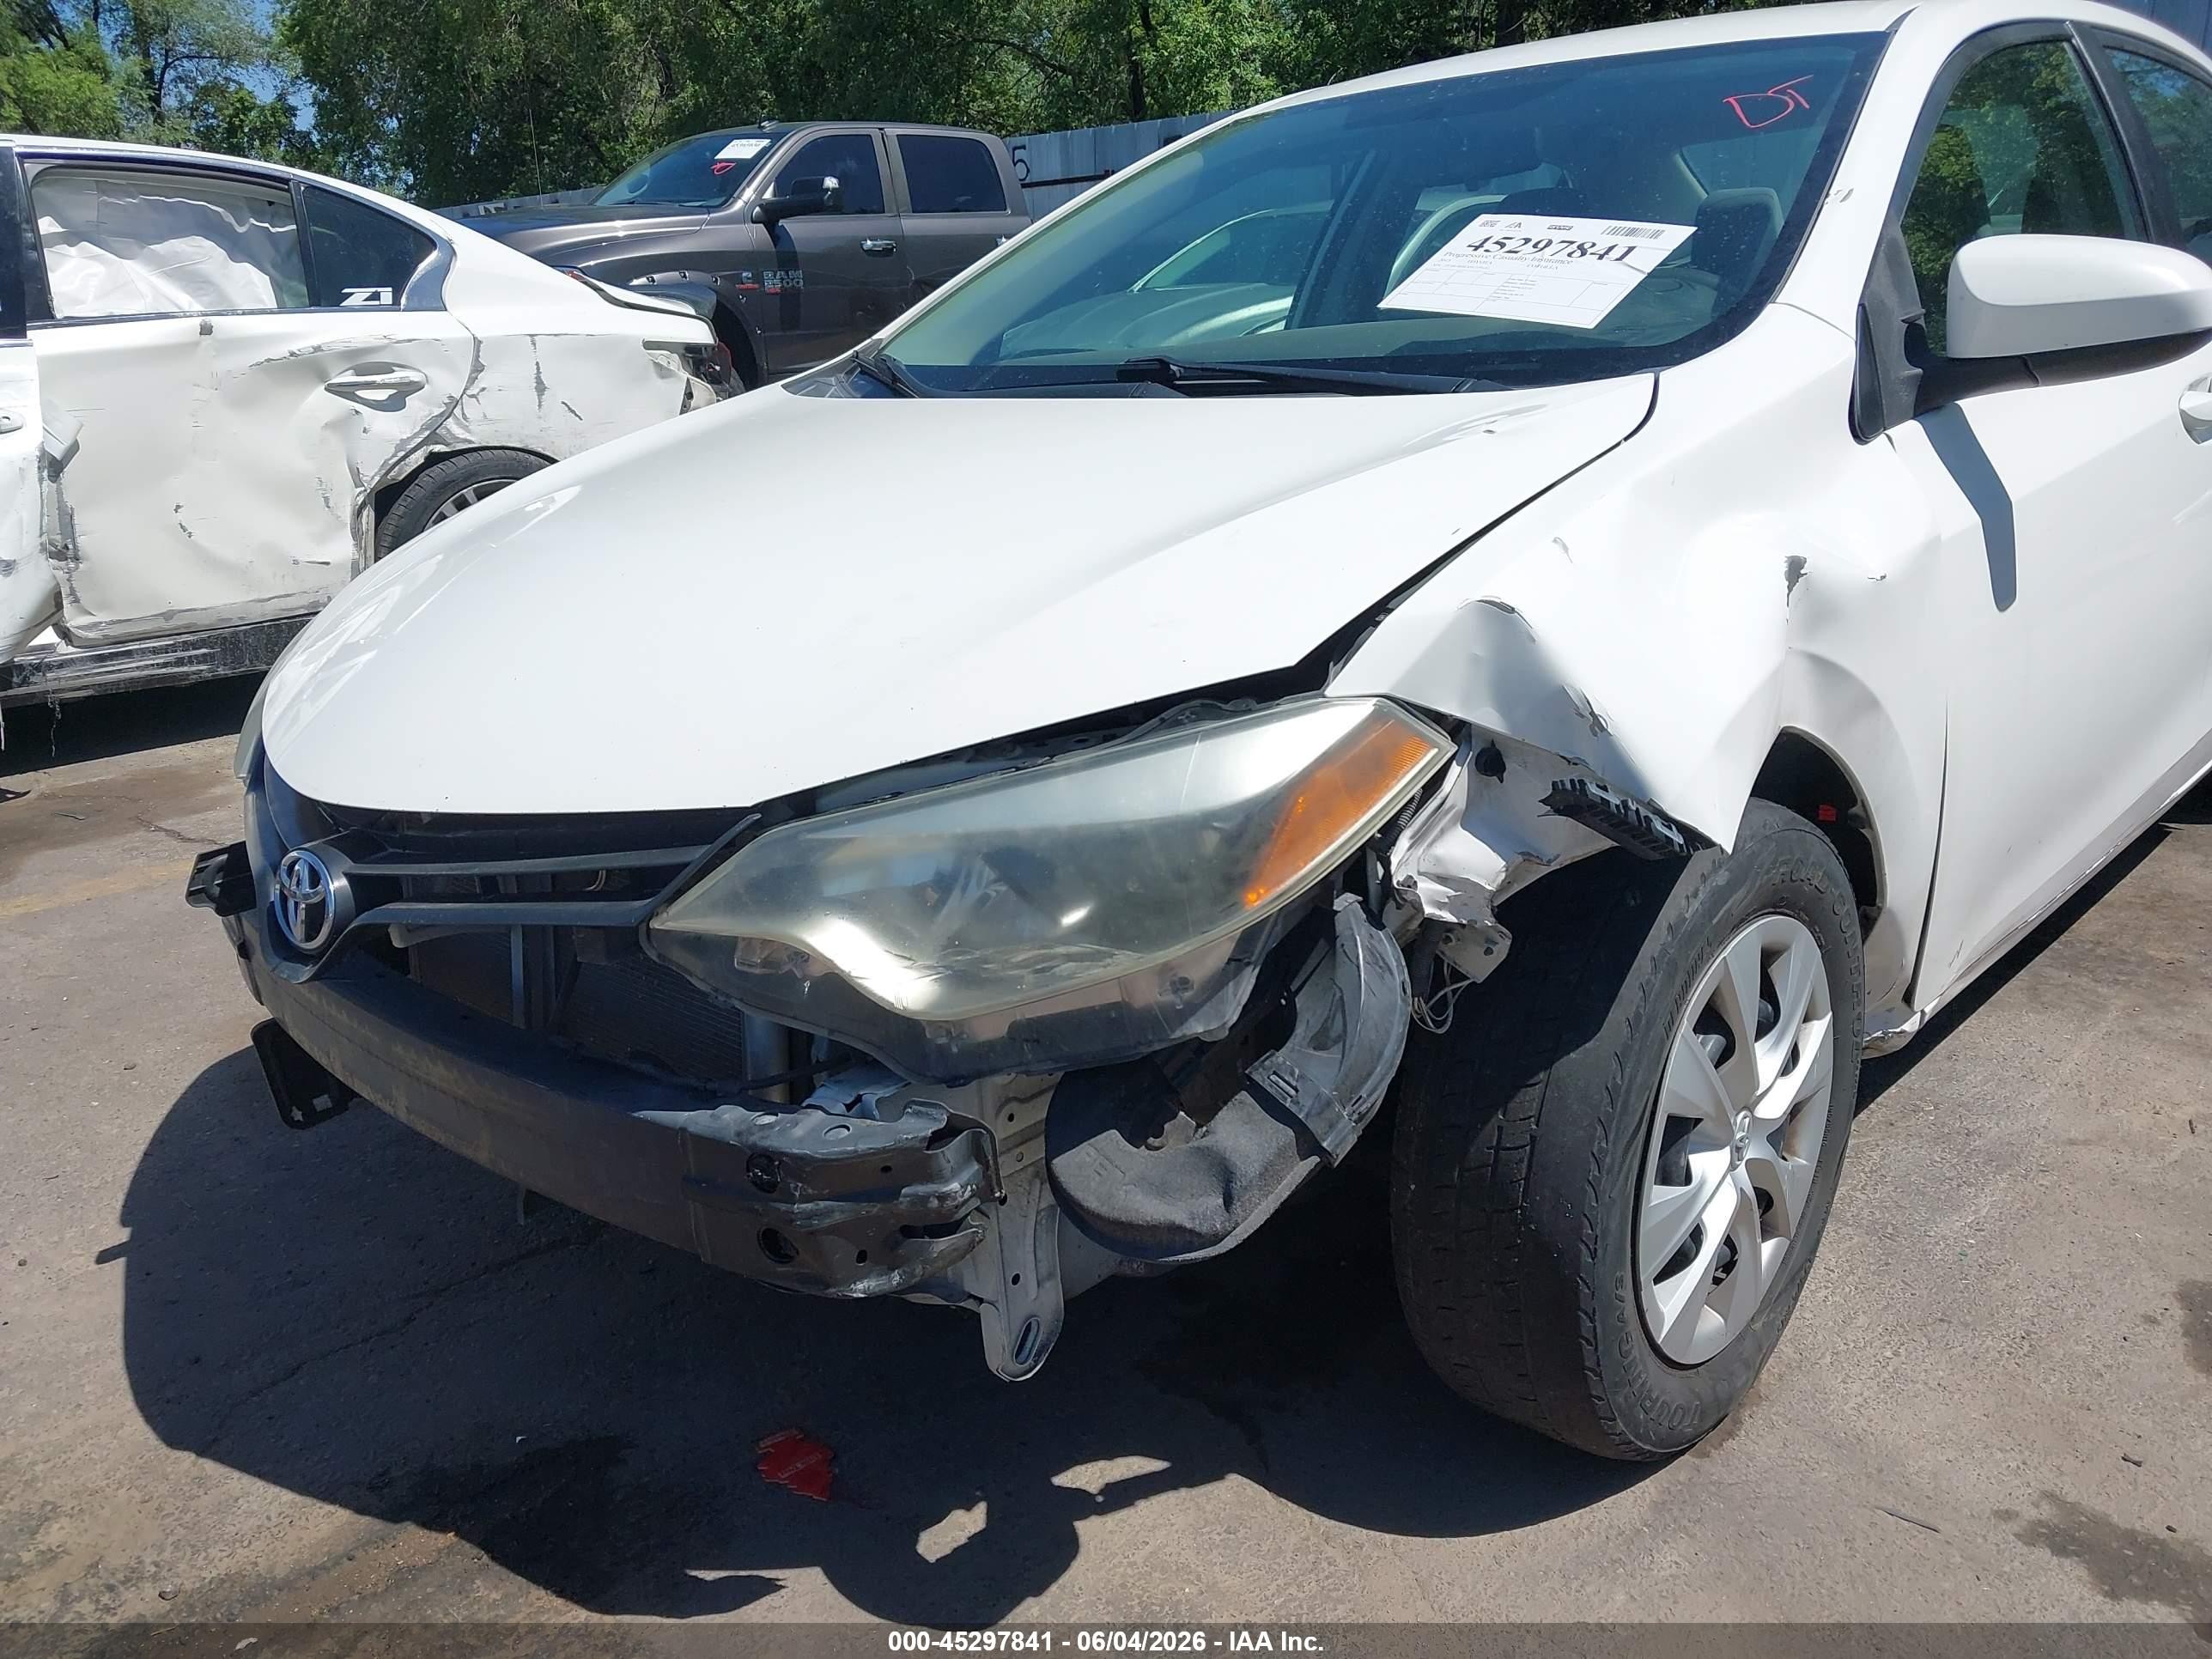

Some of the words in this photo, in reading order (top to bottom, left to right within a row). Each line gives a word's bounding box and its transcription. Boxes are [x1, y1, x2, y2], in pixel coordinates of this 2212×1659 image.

[1466, 235, 1638, 261] 45297841
[1492, 253, 1530, 262] Casualty
[1531, 255, 1573, 264] Insurance
[763, 270, 804, 279] RAM
